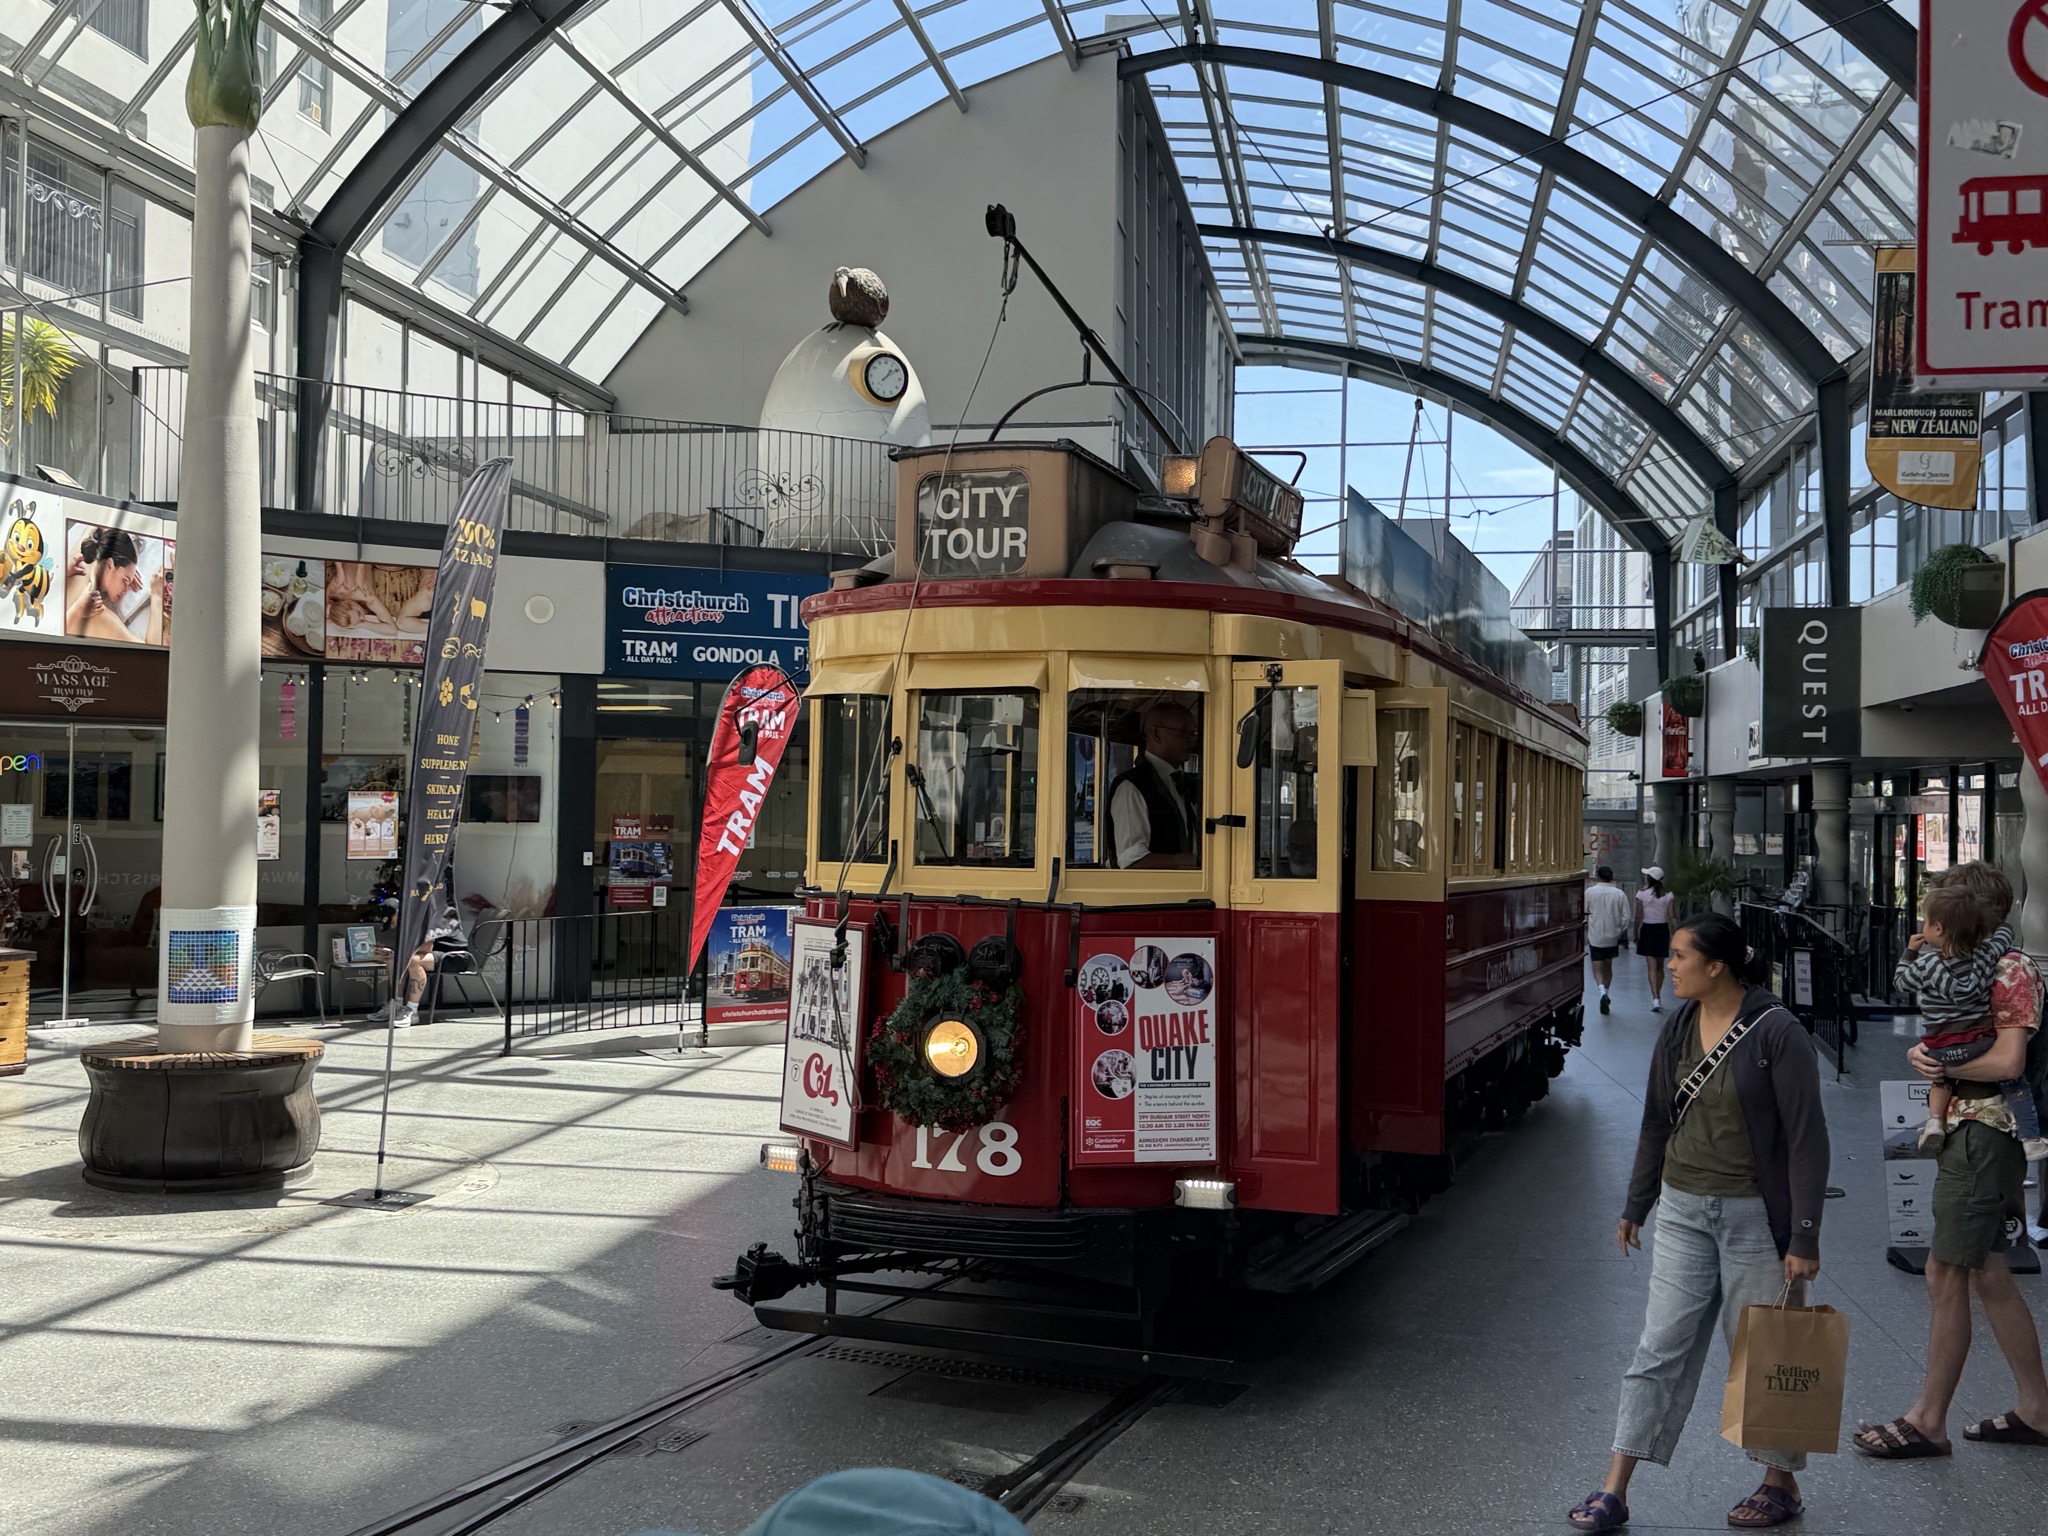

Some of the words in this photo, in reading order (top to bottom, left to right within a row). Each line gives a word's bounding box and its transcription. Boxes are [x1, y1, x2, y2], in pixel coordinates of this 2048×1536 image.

[1875, 409, 1936, 417] MARLBOROUGH
[1939, 409, 1973, 417] SOUNDS
[1891, 420, 1918, 434] NEW
[1921, 420, 1977, 435] ZEALAND
[1247, 471, 1272, 511] CITY
[936, 486, 1018, 521] CITY
[925, 527, 1028, 561] TOUR
[623, 586, 749, 613] Christchurch
[767, 594, 810, 630] TI
[645, 607, 724, 625] attractions
[622, 639, 677, 657] TRAM
[693, 646, 780, 666] GONDOLA
[2009, 637, 2048, 660] Christc
[656, 656, 672, 664] PASS
[36, 672, 109, 688] MASSAGE
[1797, 620, 1828, 743] QUEST
[2009, 669, 2048, 703] TR
[737, 706, 786, 730] TRAM
[2018, 705, 2039, 716] ALL
[437, 734, 460, 746] HONE
[0, 755, 40, 776] pen
[717, 755, 775, 857] TRAM
[614, 827, 641, 836] TRAM
[730, 926, 766, 938] TRAM
[722, 1008, 788, 1018] christchurchattractions
[1139, 1009, 1210, 1052] QUAKE
[1707, 1023, 1748, 1066] BAKER
[1151, 1046, 1198, 1081] CITY
[1085, 1119, 1102, 1127] EQC
[912, 1122, 1022, 1176] 178
[1765, 1375, 1809, 1392] TALES
[1773, 1364, 1820, 1383] Telling
